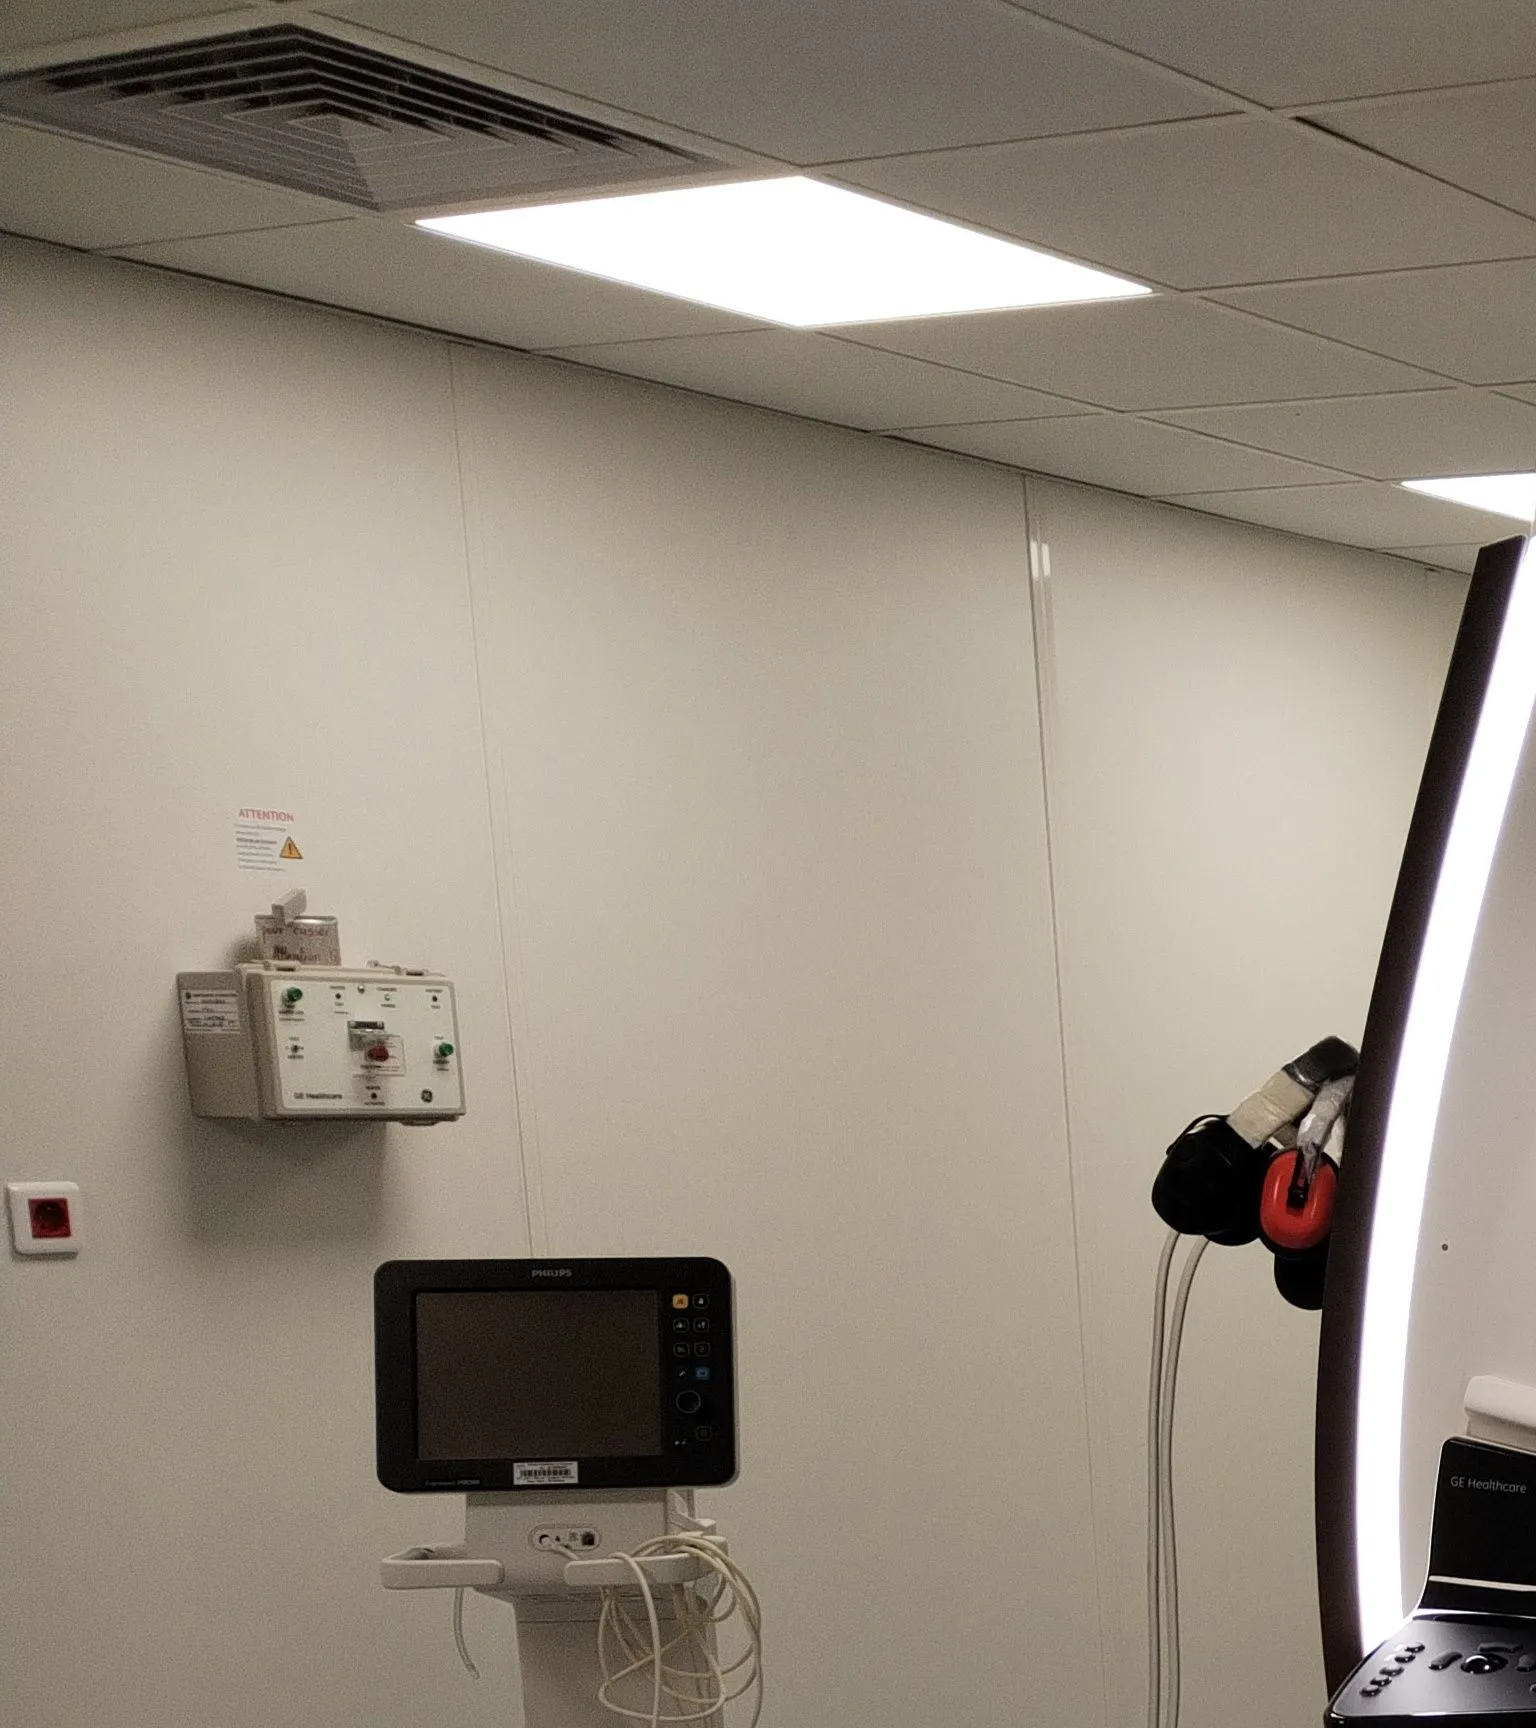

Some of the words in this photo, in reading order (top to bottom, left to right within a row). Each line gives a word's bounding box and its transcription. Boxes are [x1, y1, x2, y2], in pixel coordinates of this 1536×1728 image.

[238, 808, 294, 822] ATTENTION
[531, 1268, 572, 1277] PHILIPS
[1450, 1475, 1466, 1488] GE
[1467, 1477, 1527, 1494] Healthcare
